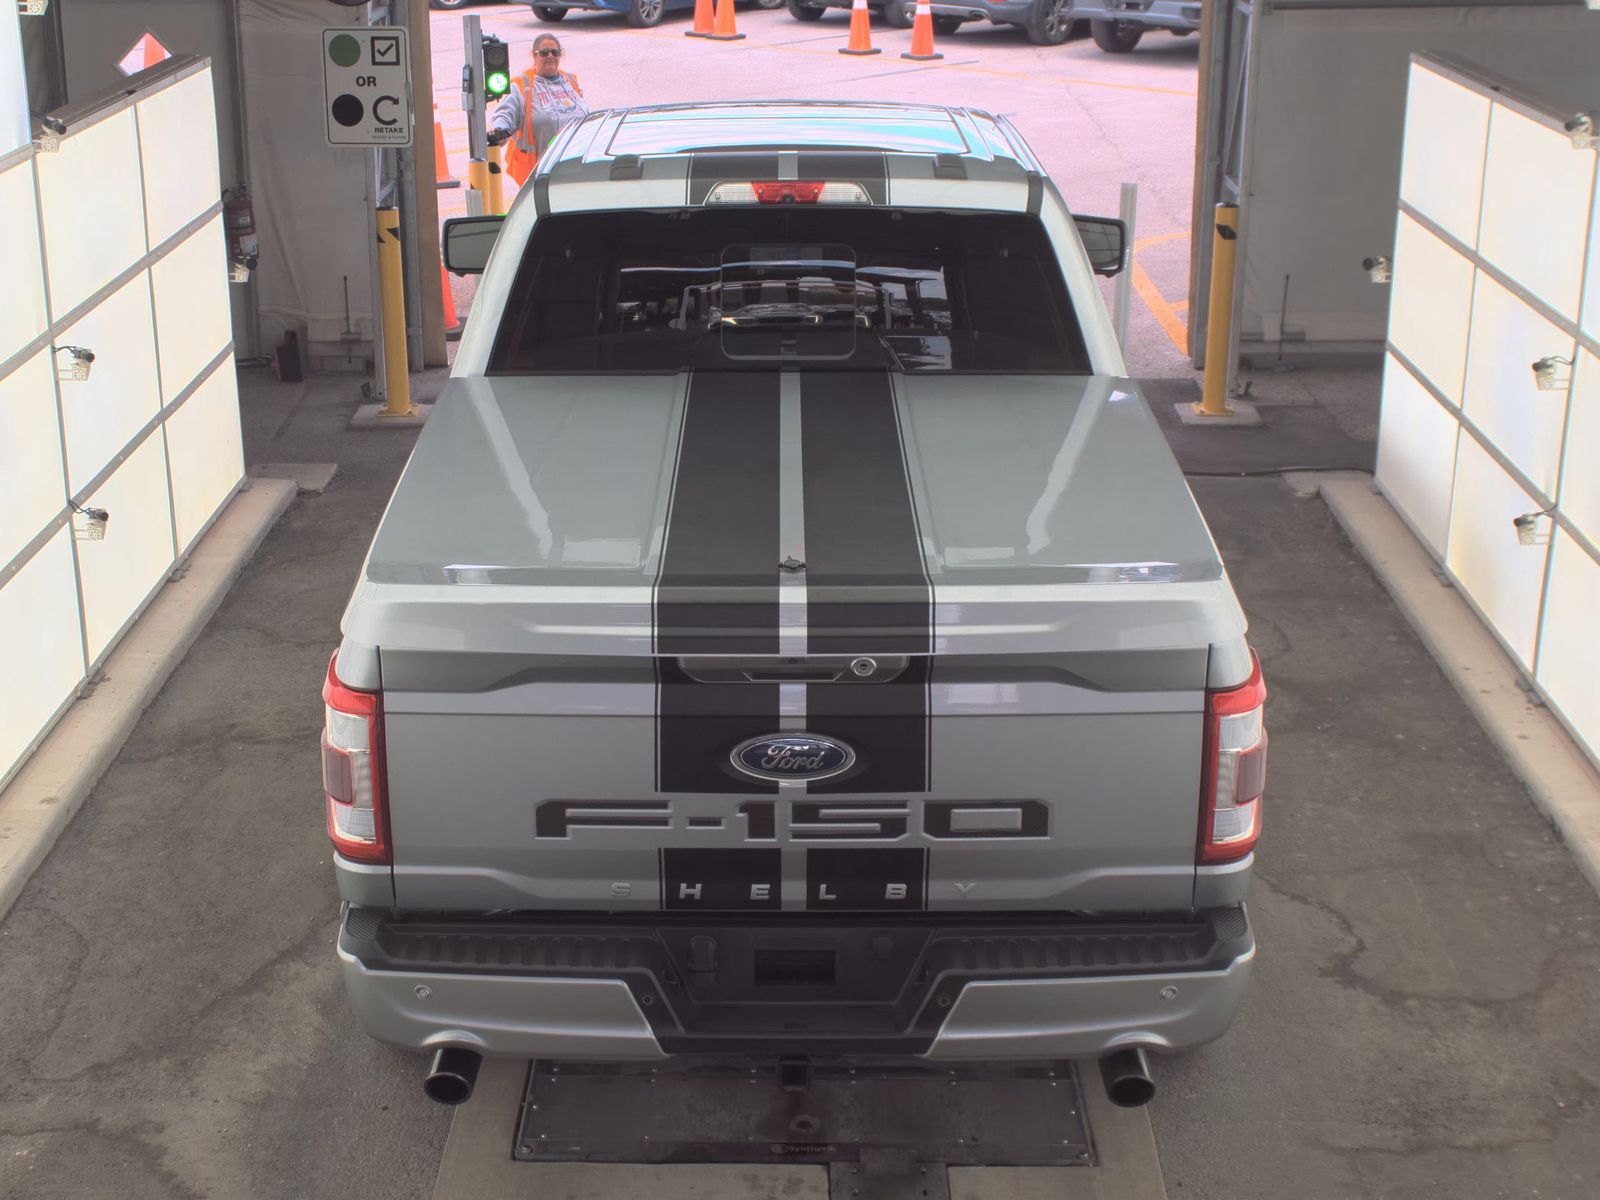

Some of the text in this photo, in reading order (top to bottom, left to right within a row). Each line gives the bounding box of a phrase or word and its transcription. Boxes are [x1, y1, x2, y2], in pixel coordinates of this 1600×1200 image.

[355, 75, 377, 87] OR
[761, 745, 826, 770] Ford
[535, 799, 1051, 841] F-150
